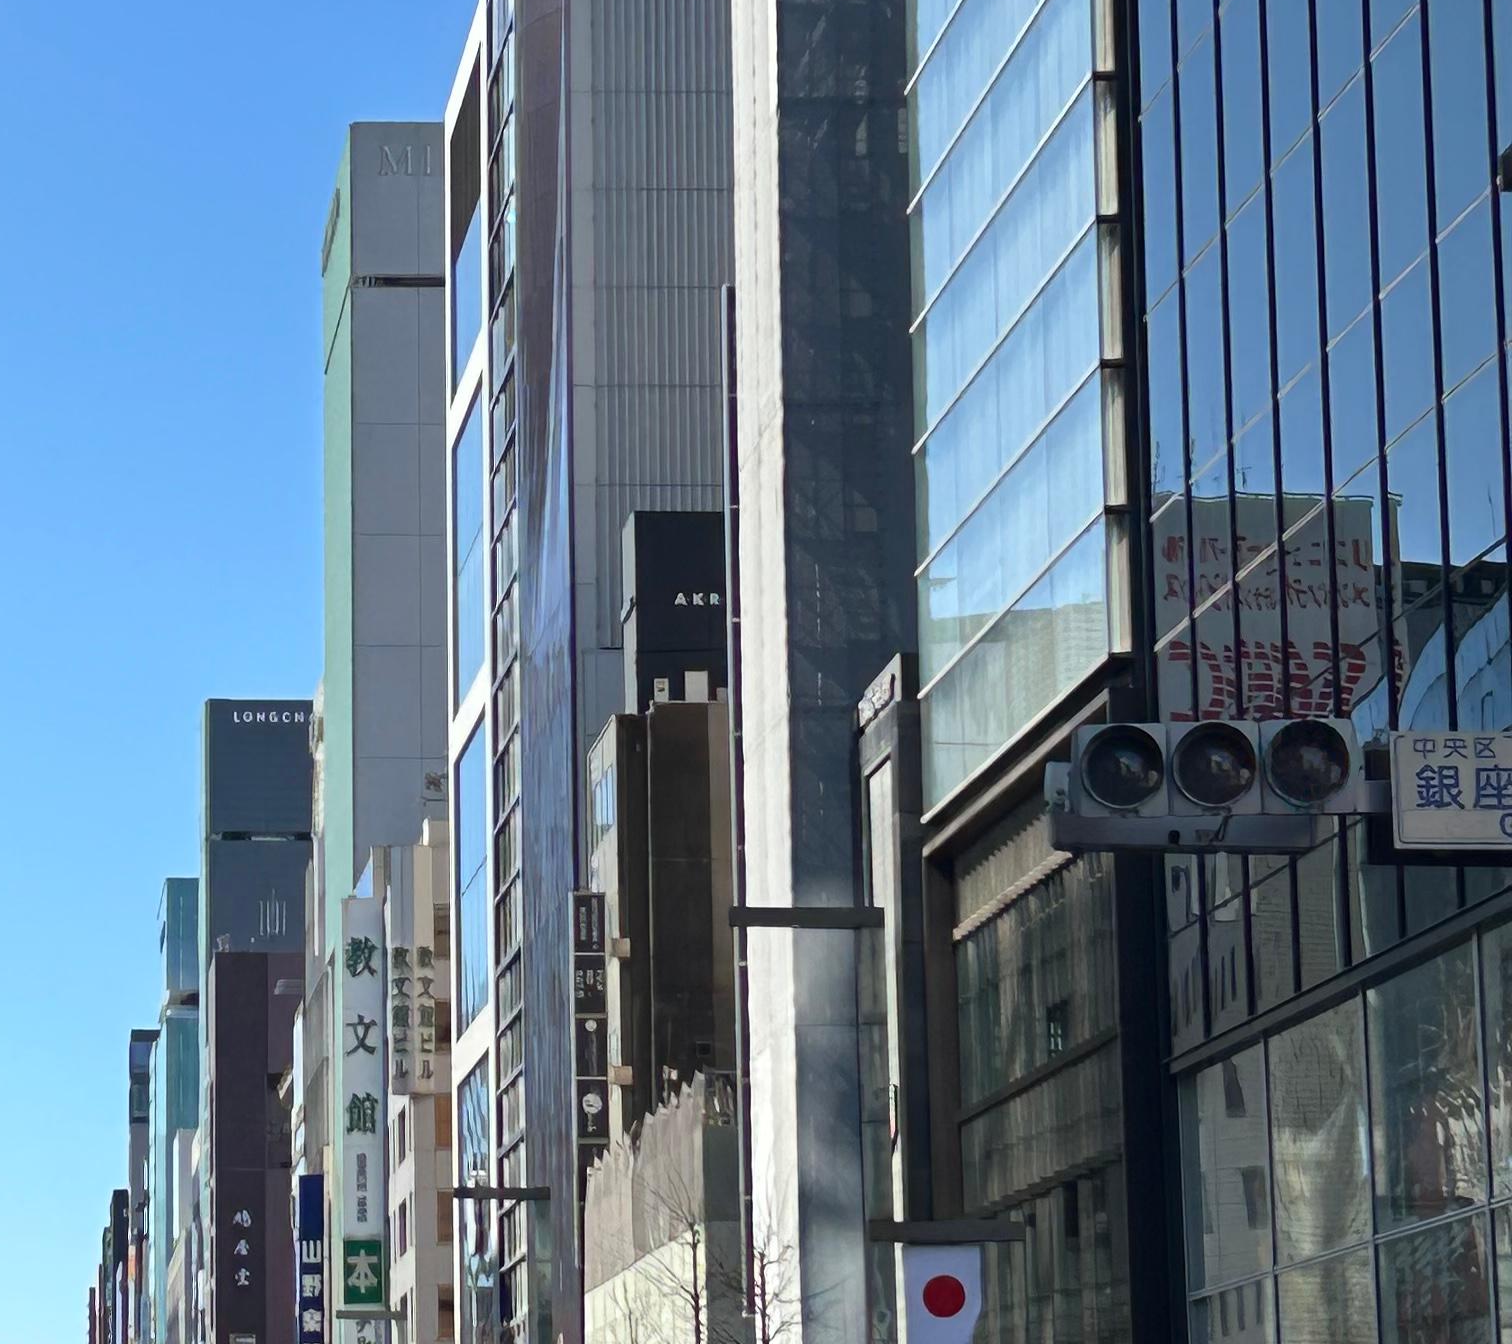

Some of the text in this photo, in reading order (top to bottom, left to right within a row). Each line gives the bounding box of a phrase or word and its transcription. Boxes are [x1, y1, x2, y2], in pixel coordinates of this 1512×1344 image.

[1413, 737, 1497, 760] 中央区
[1415, 763, 1512, 811] 銀座
[345, 935, 379, 1135] 教文館
[346, 1248, 379, 1295] 本
